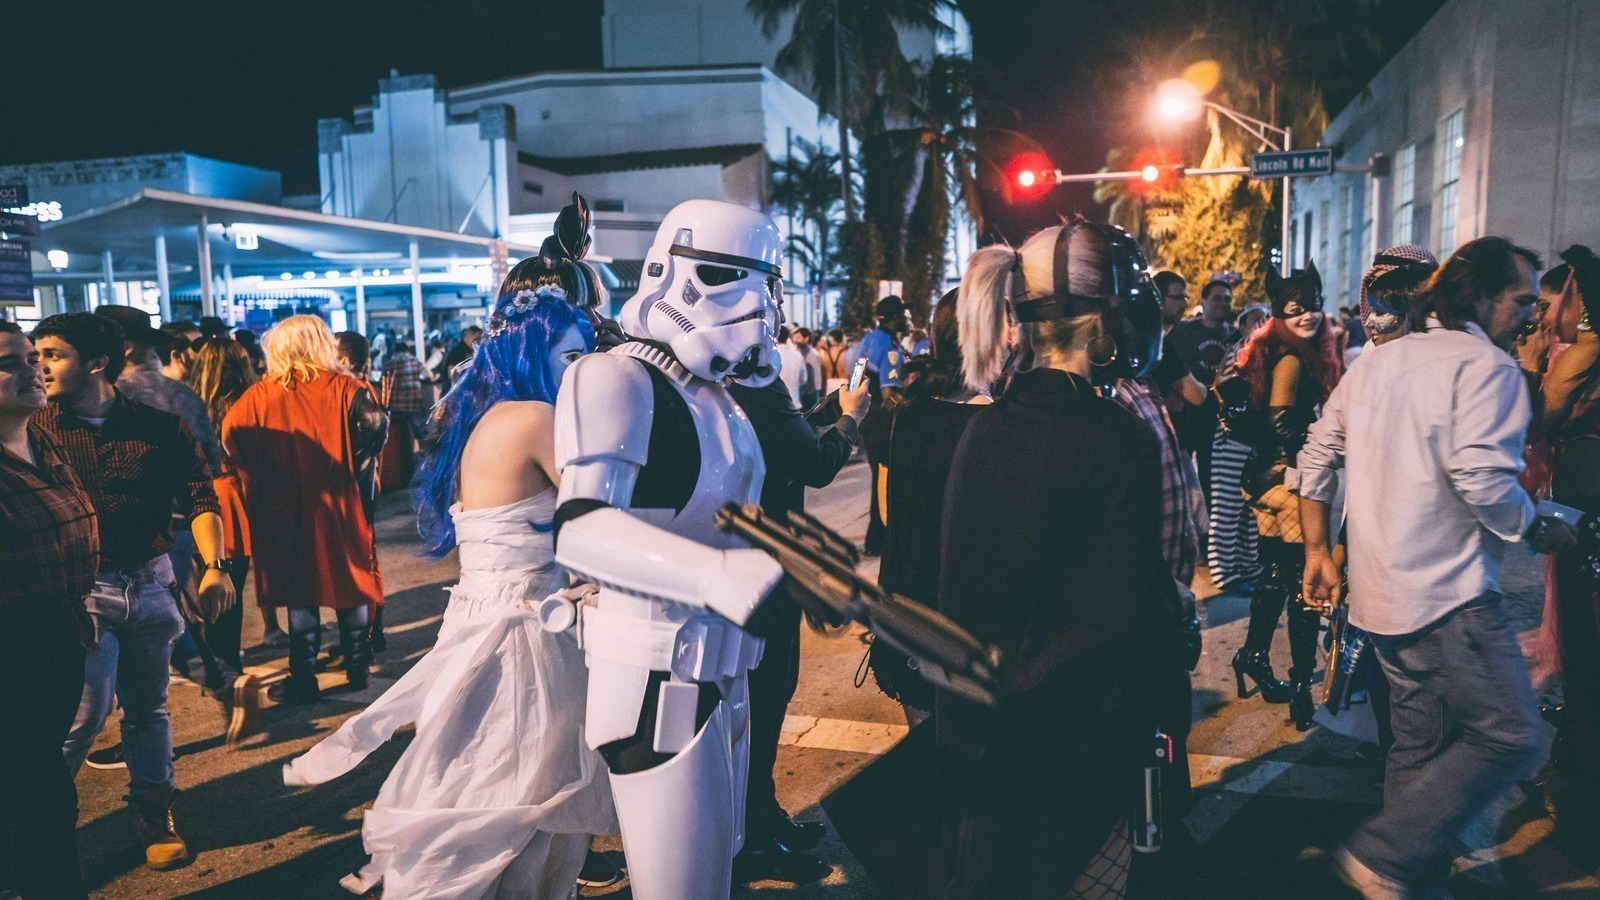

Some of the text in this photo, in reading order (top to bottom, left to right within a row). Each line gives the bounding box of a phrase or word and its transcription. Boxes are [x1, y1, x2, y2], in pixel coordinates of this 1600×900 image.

[1253, 156, 1329, 172] Lincoln Rd Mall
